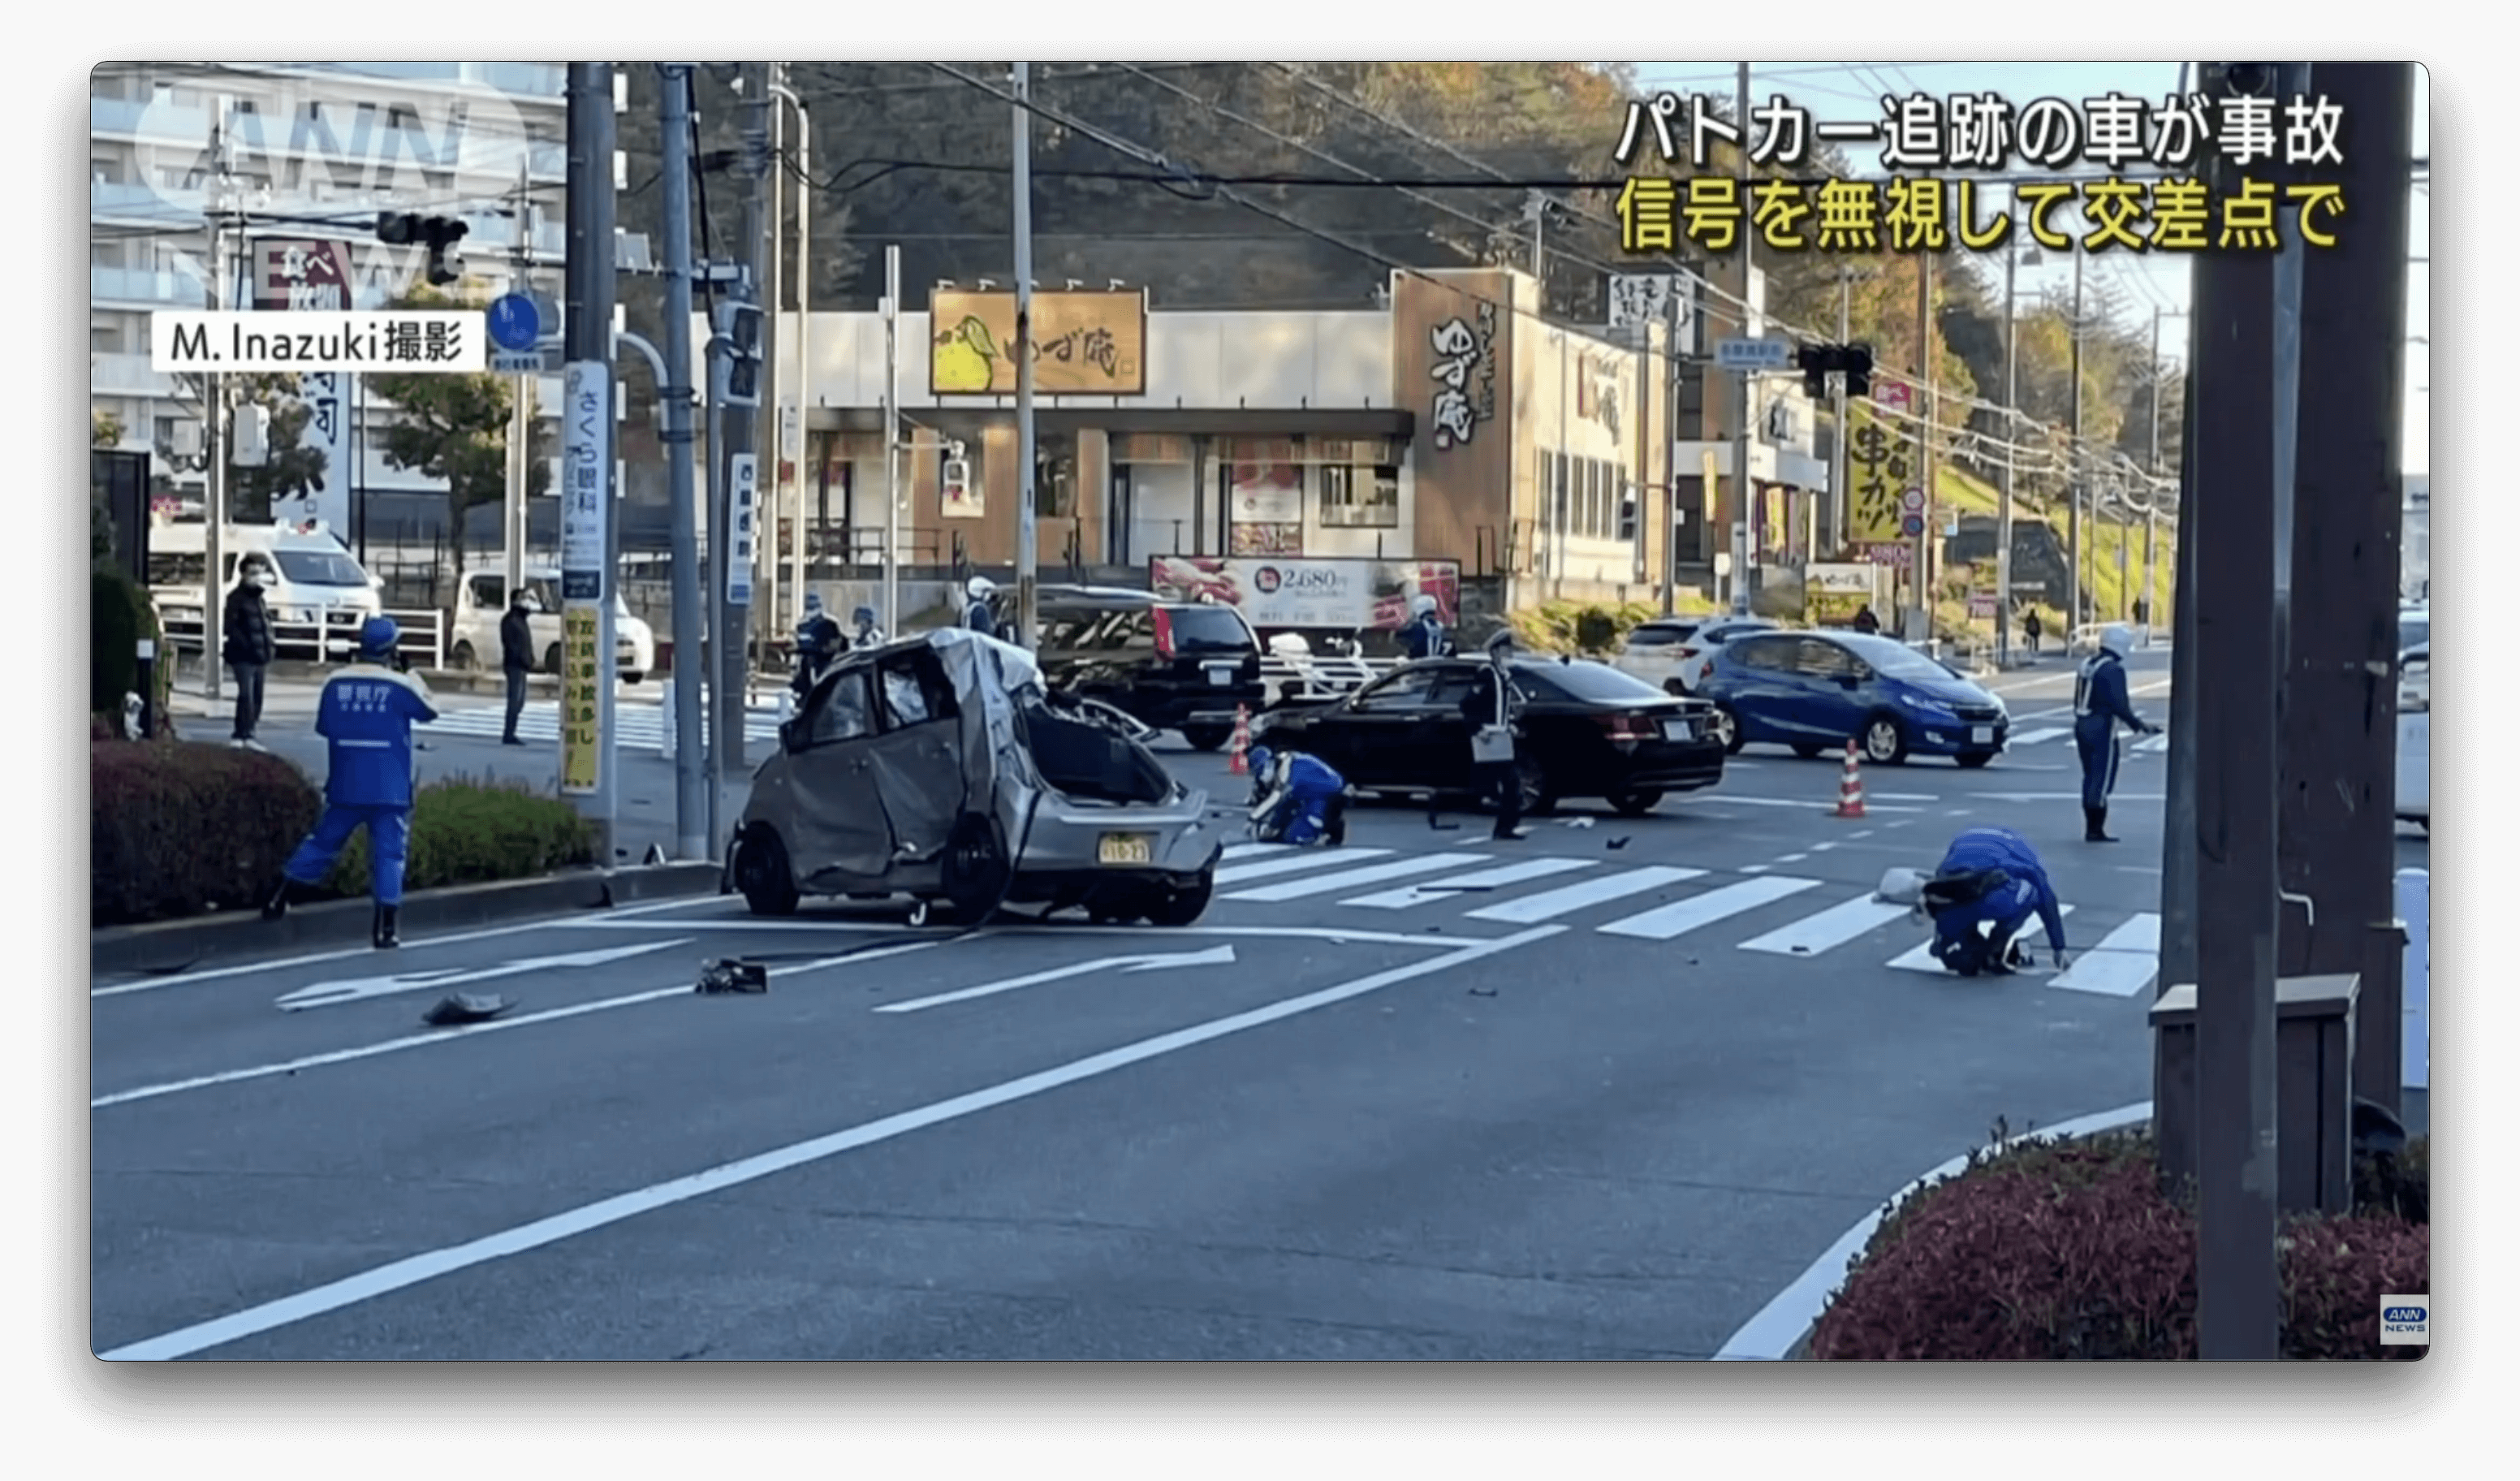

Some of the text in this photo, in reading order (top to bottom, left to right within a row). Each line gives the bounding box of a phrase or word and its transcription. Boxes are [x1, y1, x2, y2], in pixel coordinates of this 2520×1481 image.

[1431, 317, 1478, 443] ゆず庵
[578, 391, 598, 515] さくら眼科
[1851, 422, 1890, 531] 串カツ
